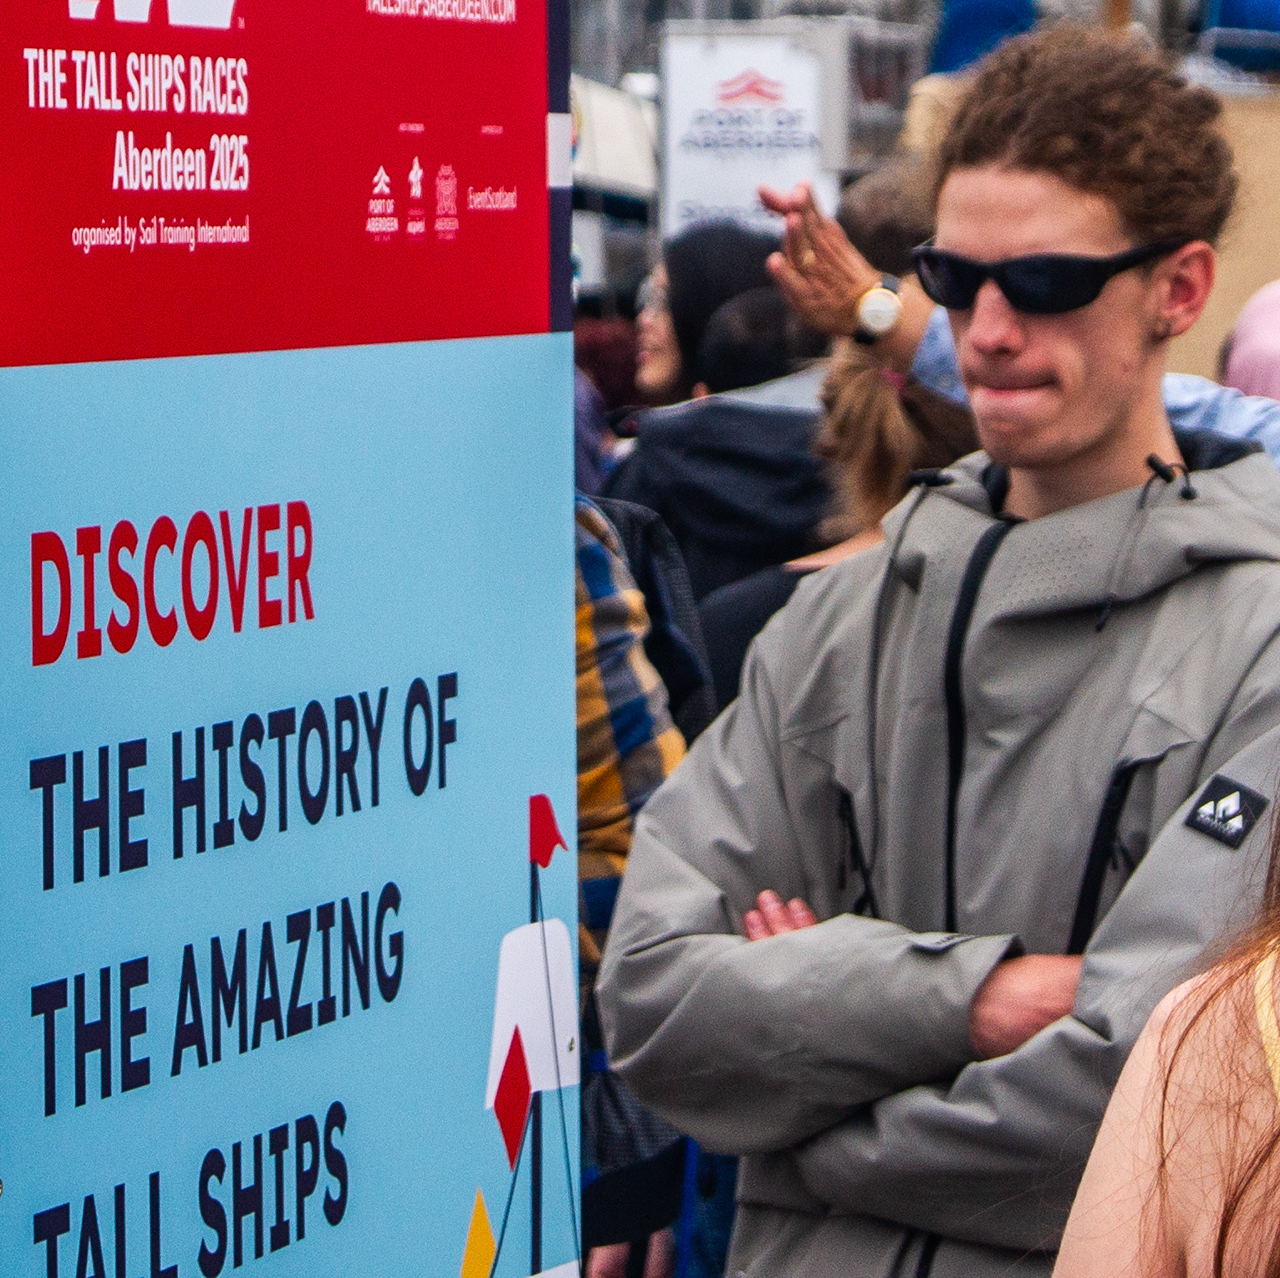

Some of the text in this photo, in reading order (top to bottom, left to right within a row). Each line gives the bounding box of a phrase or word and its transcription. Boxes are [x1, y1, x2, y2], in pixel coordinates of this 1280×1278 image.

[22, 47, 249, 115] THE TALL SHIPS RACES
[111, 130, 250, 191] Aberdeen 2025
[72, 214, 250, 255] organised by Sail Training International
[31, 500, 316, 667] DISCOVER
[29, 671, 459, 891] THE HISTORY OF
[30, 880, 405, 1118] THE AMAZING
[33, 1100, 349, 1278] TALL SHIPS
